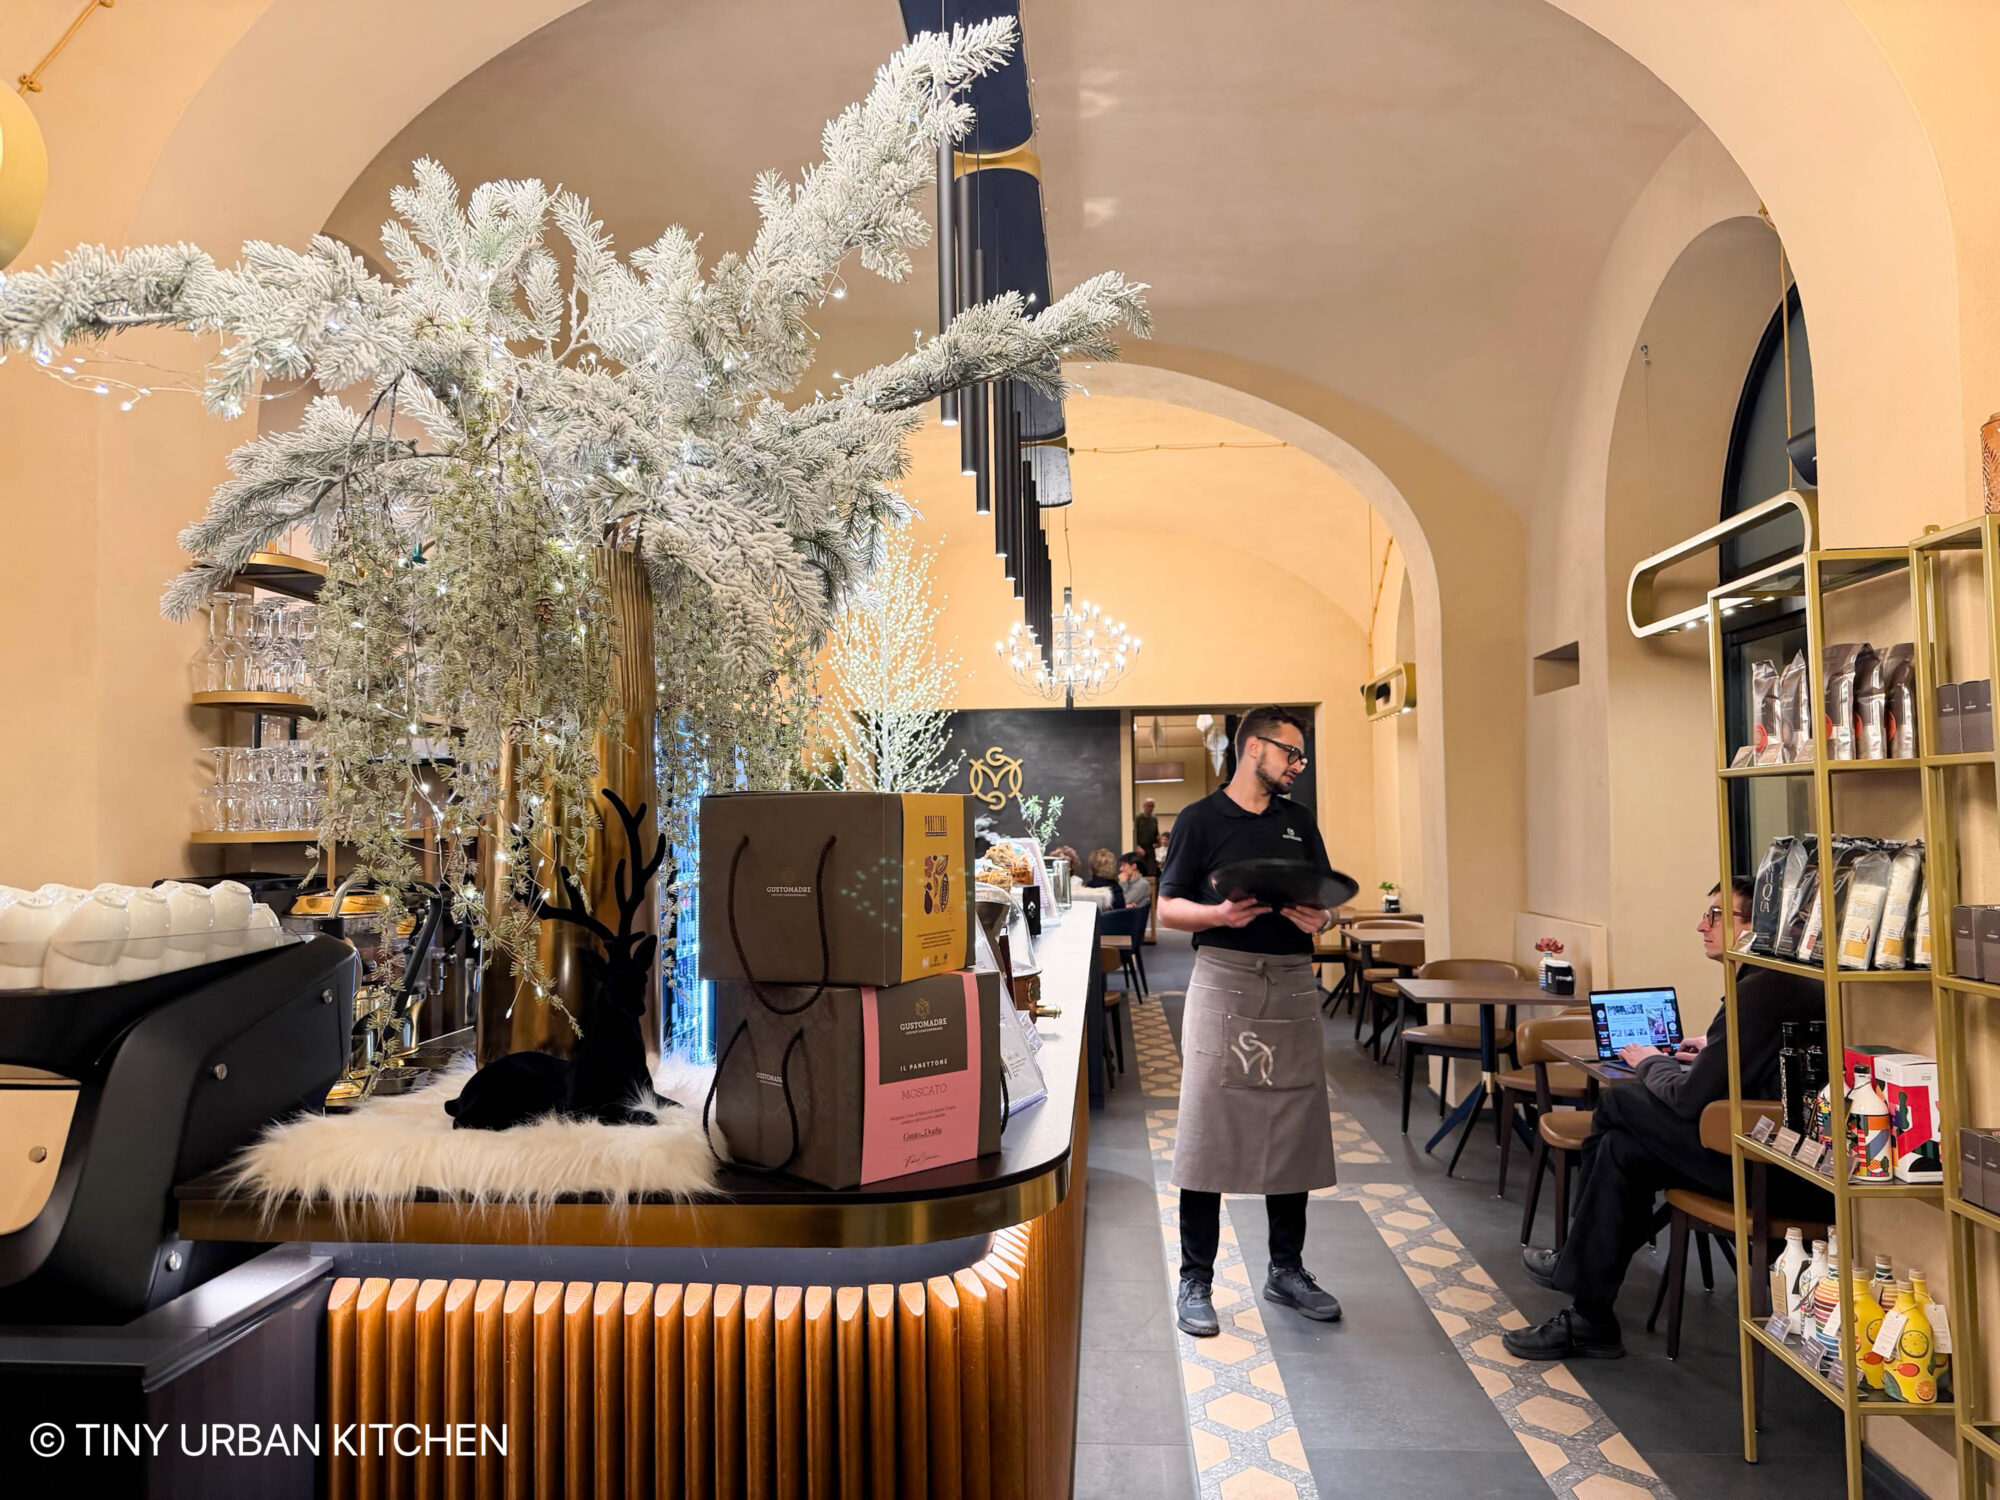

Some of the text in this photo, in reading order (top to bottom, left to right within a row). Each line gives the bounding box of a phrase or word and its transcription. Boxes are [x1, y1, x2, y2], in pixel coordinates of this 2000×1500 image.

[900, 1017, 948, 1031] GUSTOMADRE
[909, 1058, 948, 1070] PANETTONE
[902, 1082, 947, 1100] MOSCATO
